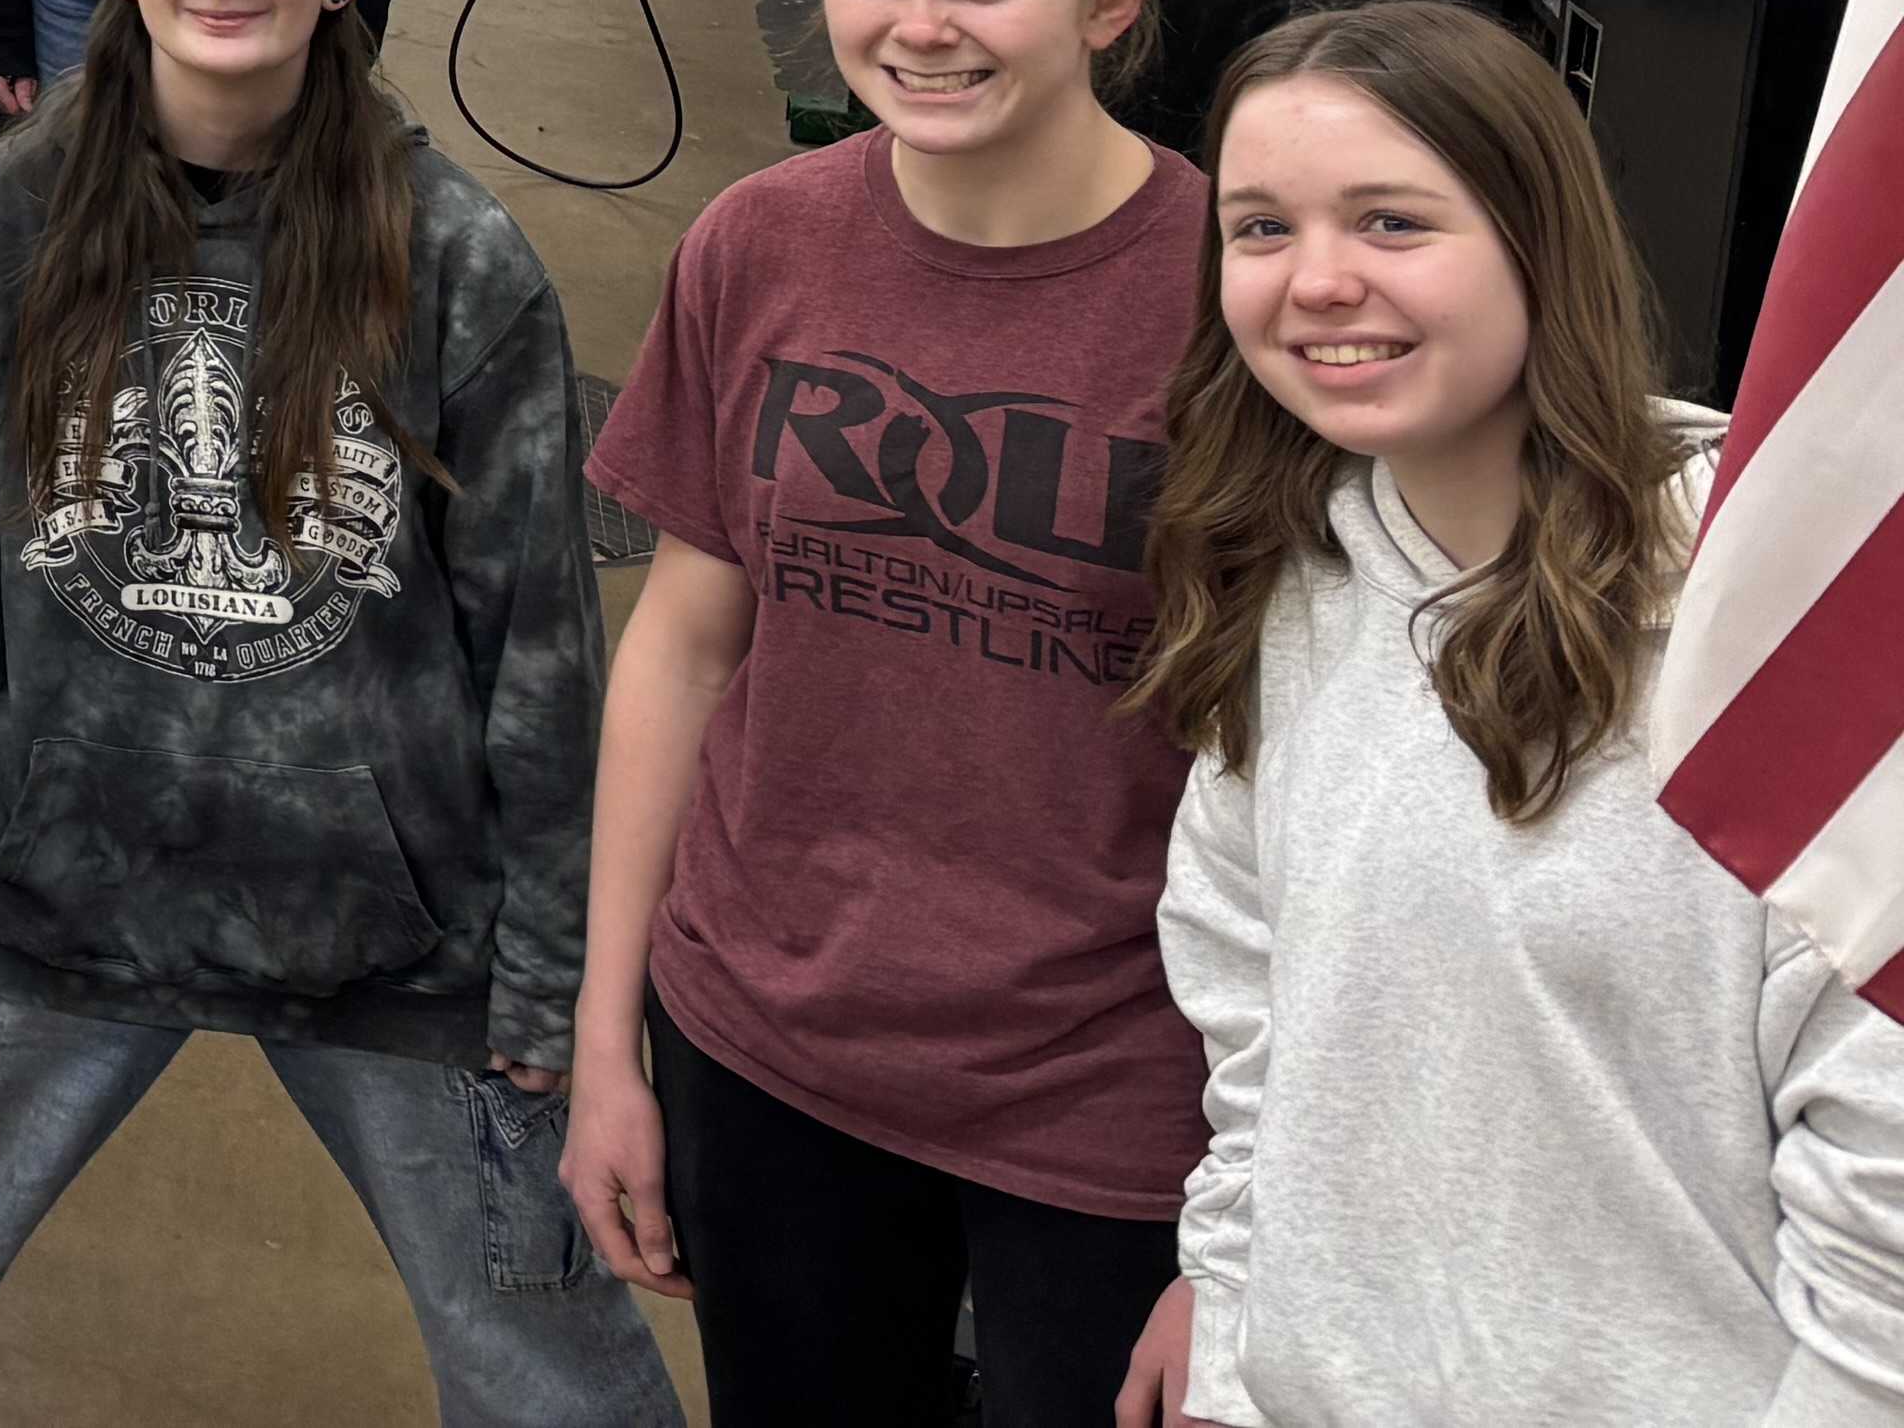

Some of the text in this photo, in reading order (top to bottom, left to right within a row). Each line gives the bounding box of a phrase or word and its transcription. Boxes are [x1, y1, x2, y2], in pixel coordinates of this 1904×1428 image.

[333, 444, 380, 469] ALITY
[300, 477, 381, 515] CSTOM
[308, 525, 368, 558] GOODS
[136, 587, 279, 618] LOUISIANA
[64, 572, 351, 669] FRENCH QUARTER
[762, 562, 1140, 687] RESTLING
